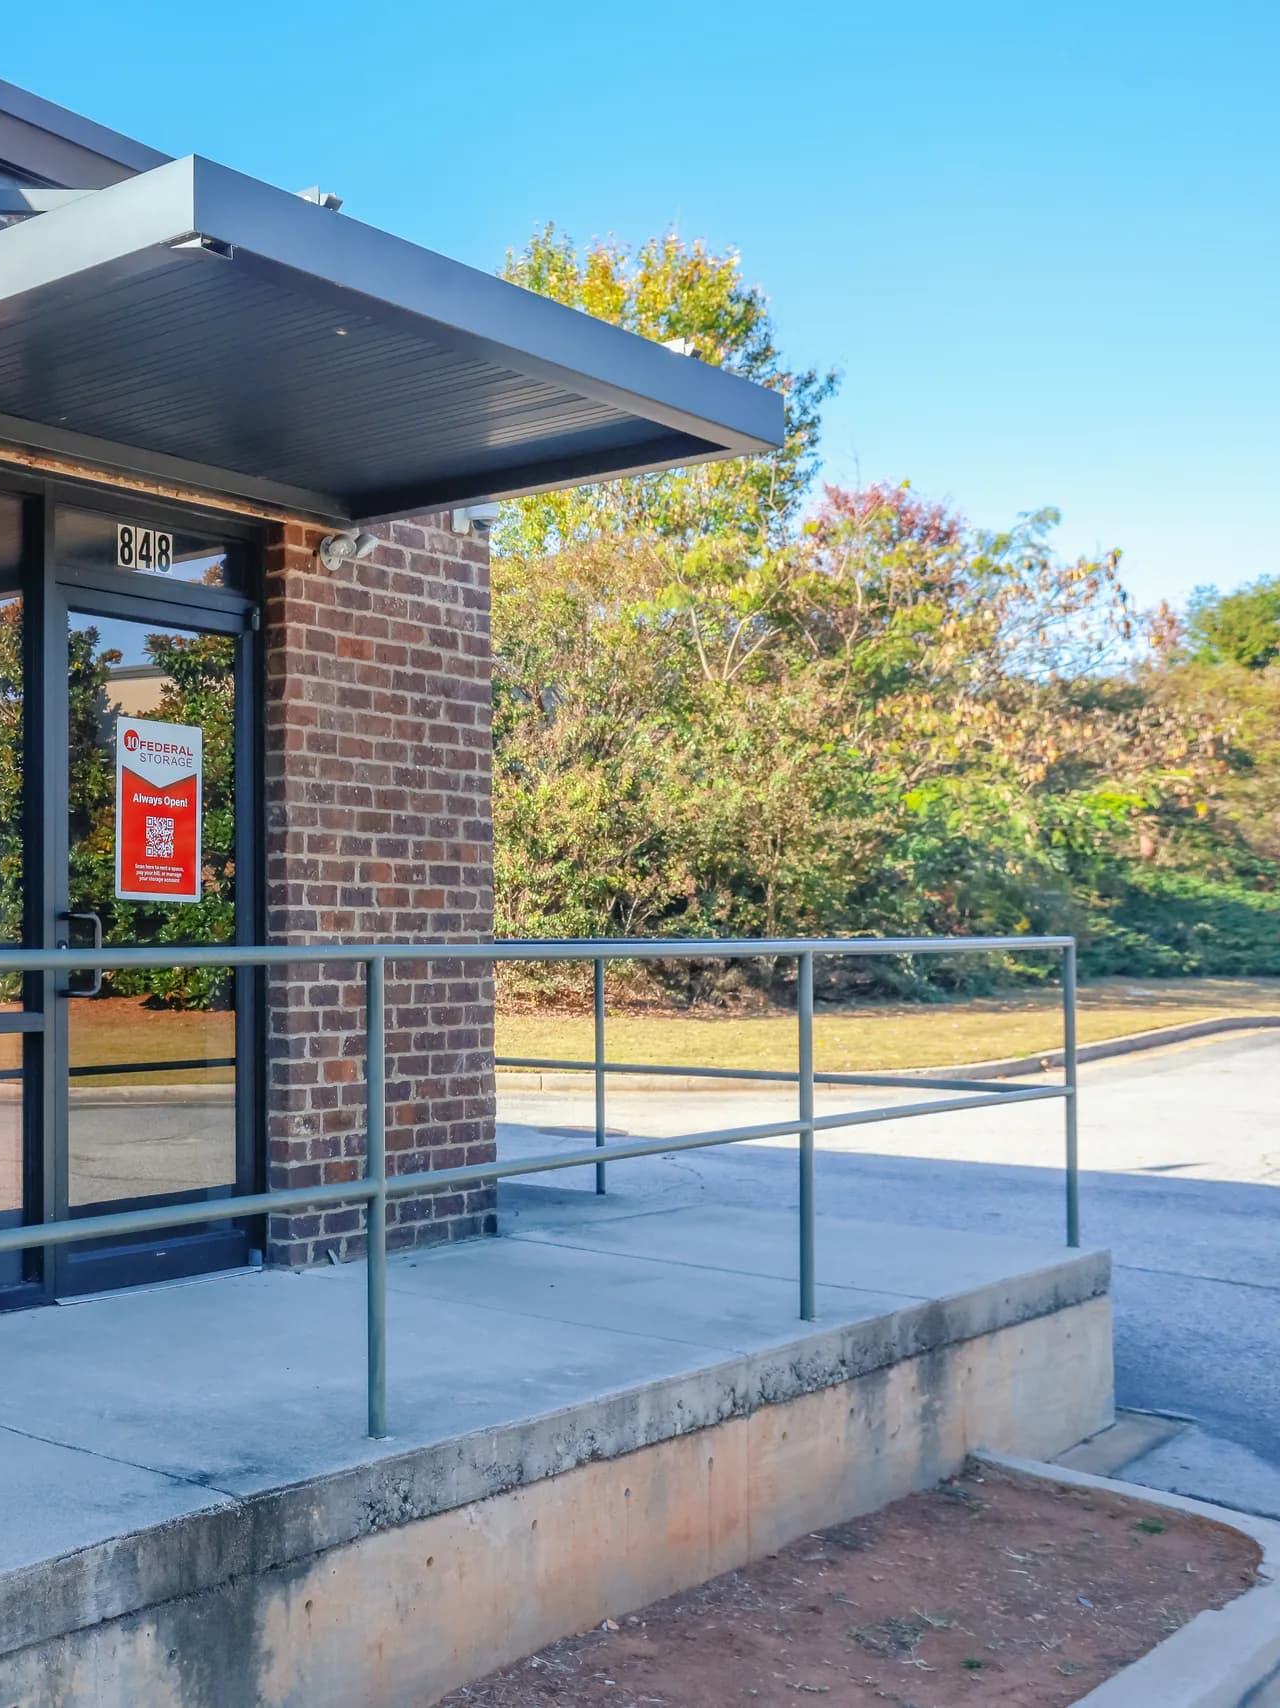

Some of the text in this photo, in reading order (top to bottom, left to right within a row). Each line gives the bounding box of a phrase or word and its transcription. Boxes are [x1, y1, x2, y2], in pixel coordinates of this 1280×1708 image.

[120, 526, 171, 573] 848
[126, 735, 194, 757] 10 FEDERAL
[139, 752, 193, 768] STORAGE
[132, 792, 188, 808] Always Open!
